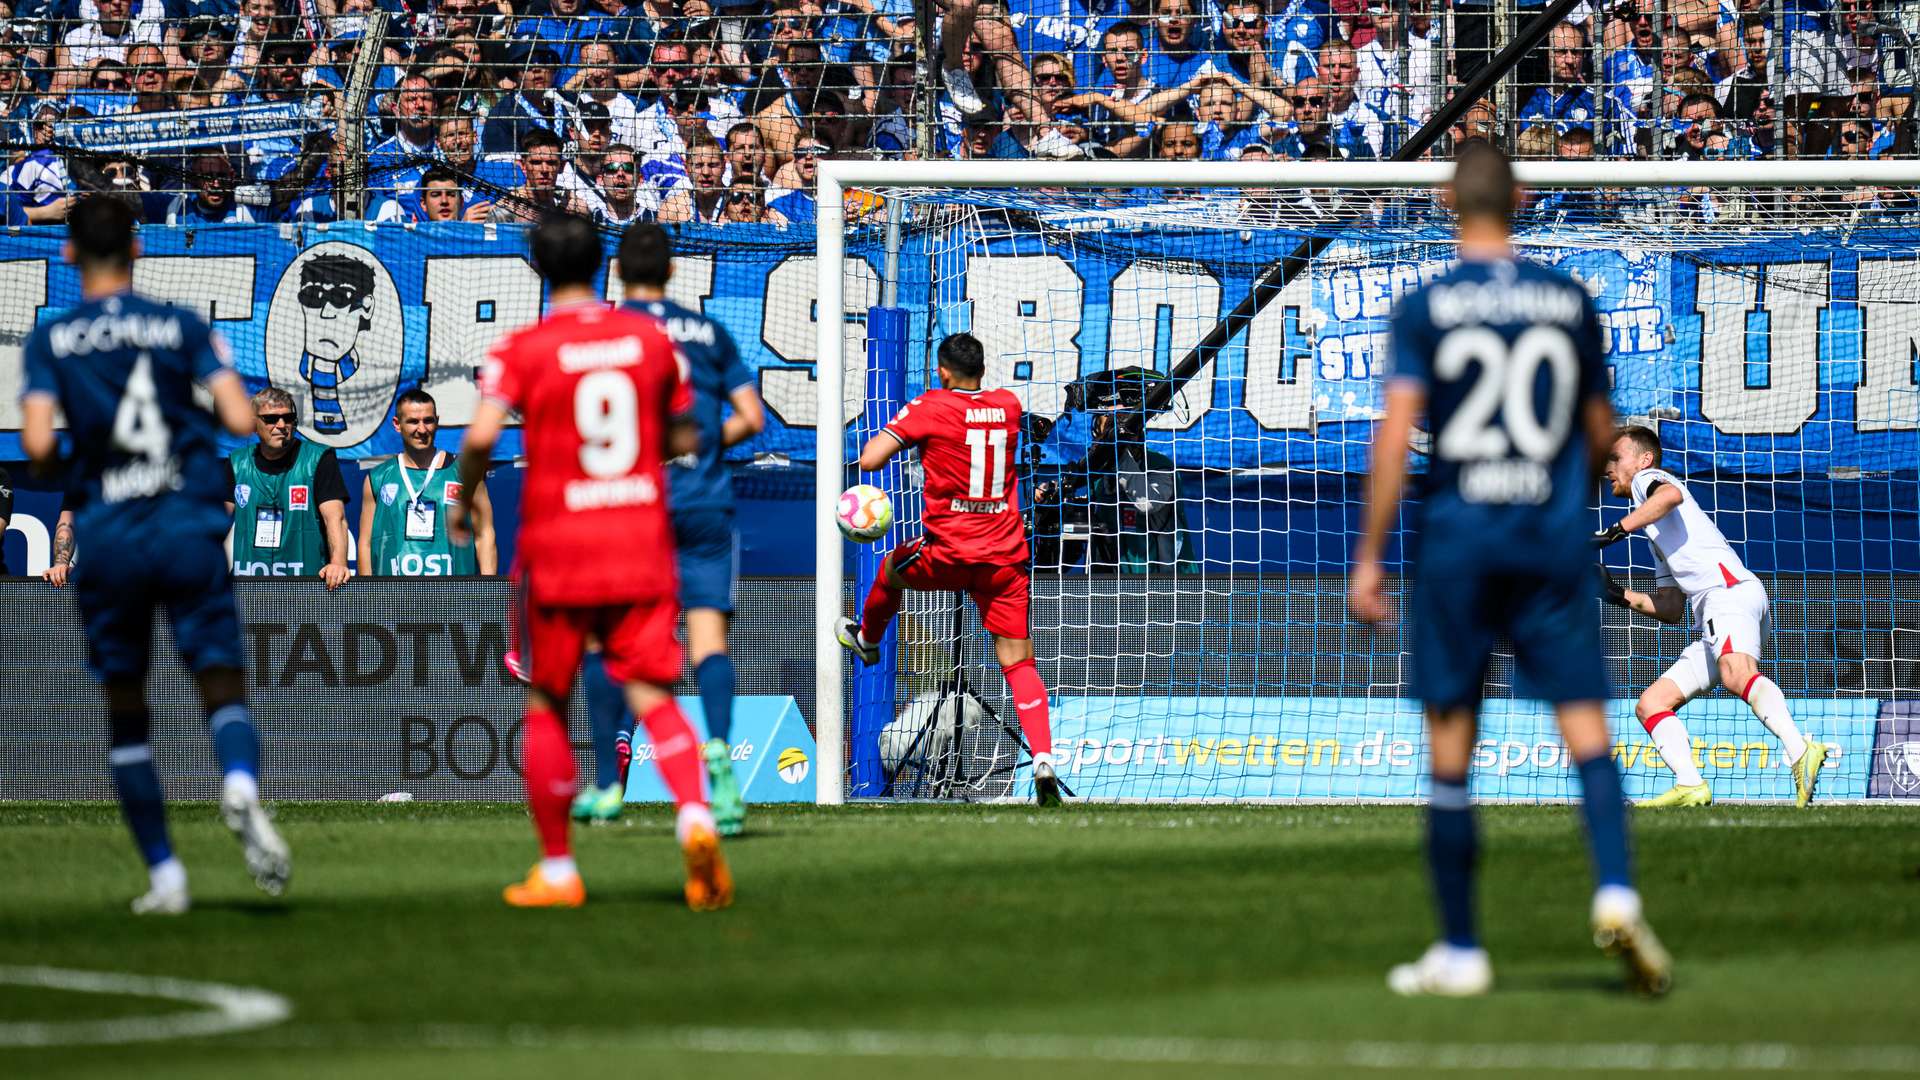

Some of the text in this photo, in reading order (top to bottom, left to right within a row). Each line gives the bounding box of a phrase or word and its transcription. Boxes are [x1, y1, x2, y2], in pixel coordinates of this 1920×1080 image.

[113, 350, 170, 463] 4
[965, 408, 1006, 423] AMIRI
[1434, 324, 1580, 460] 20
[573, 369, 641, 480] 9
[965, 429, 1008, 498] 11
[234, 561, 304, 577] HOST
[1707, 618, 1715, 637] 1
[1050, 730, 1413, 774] sportwetten.de
